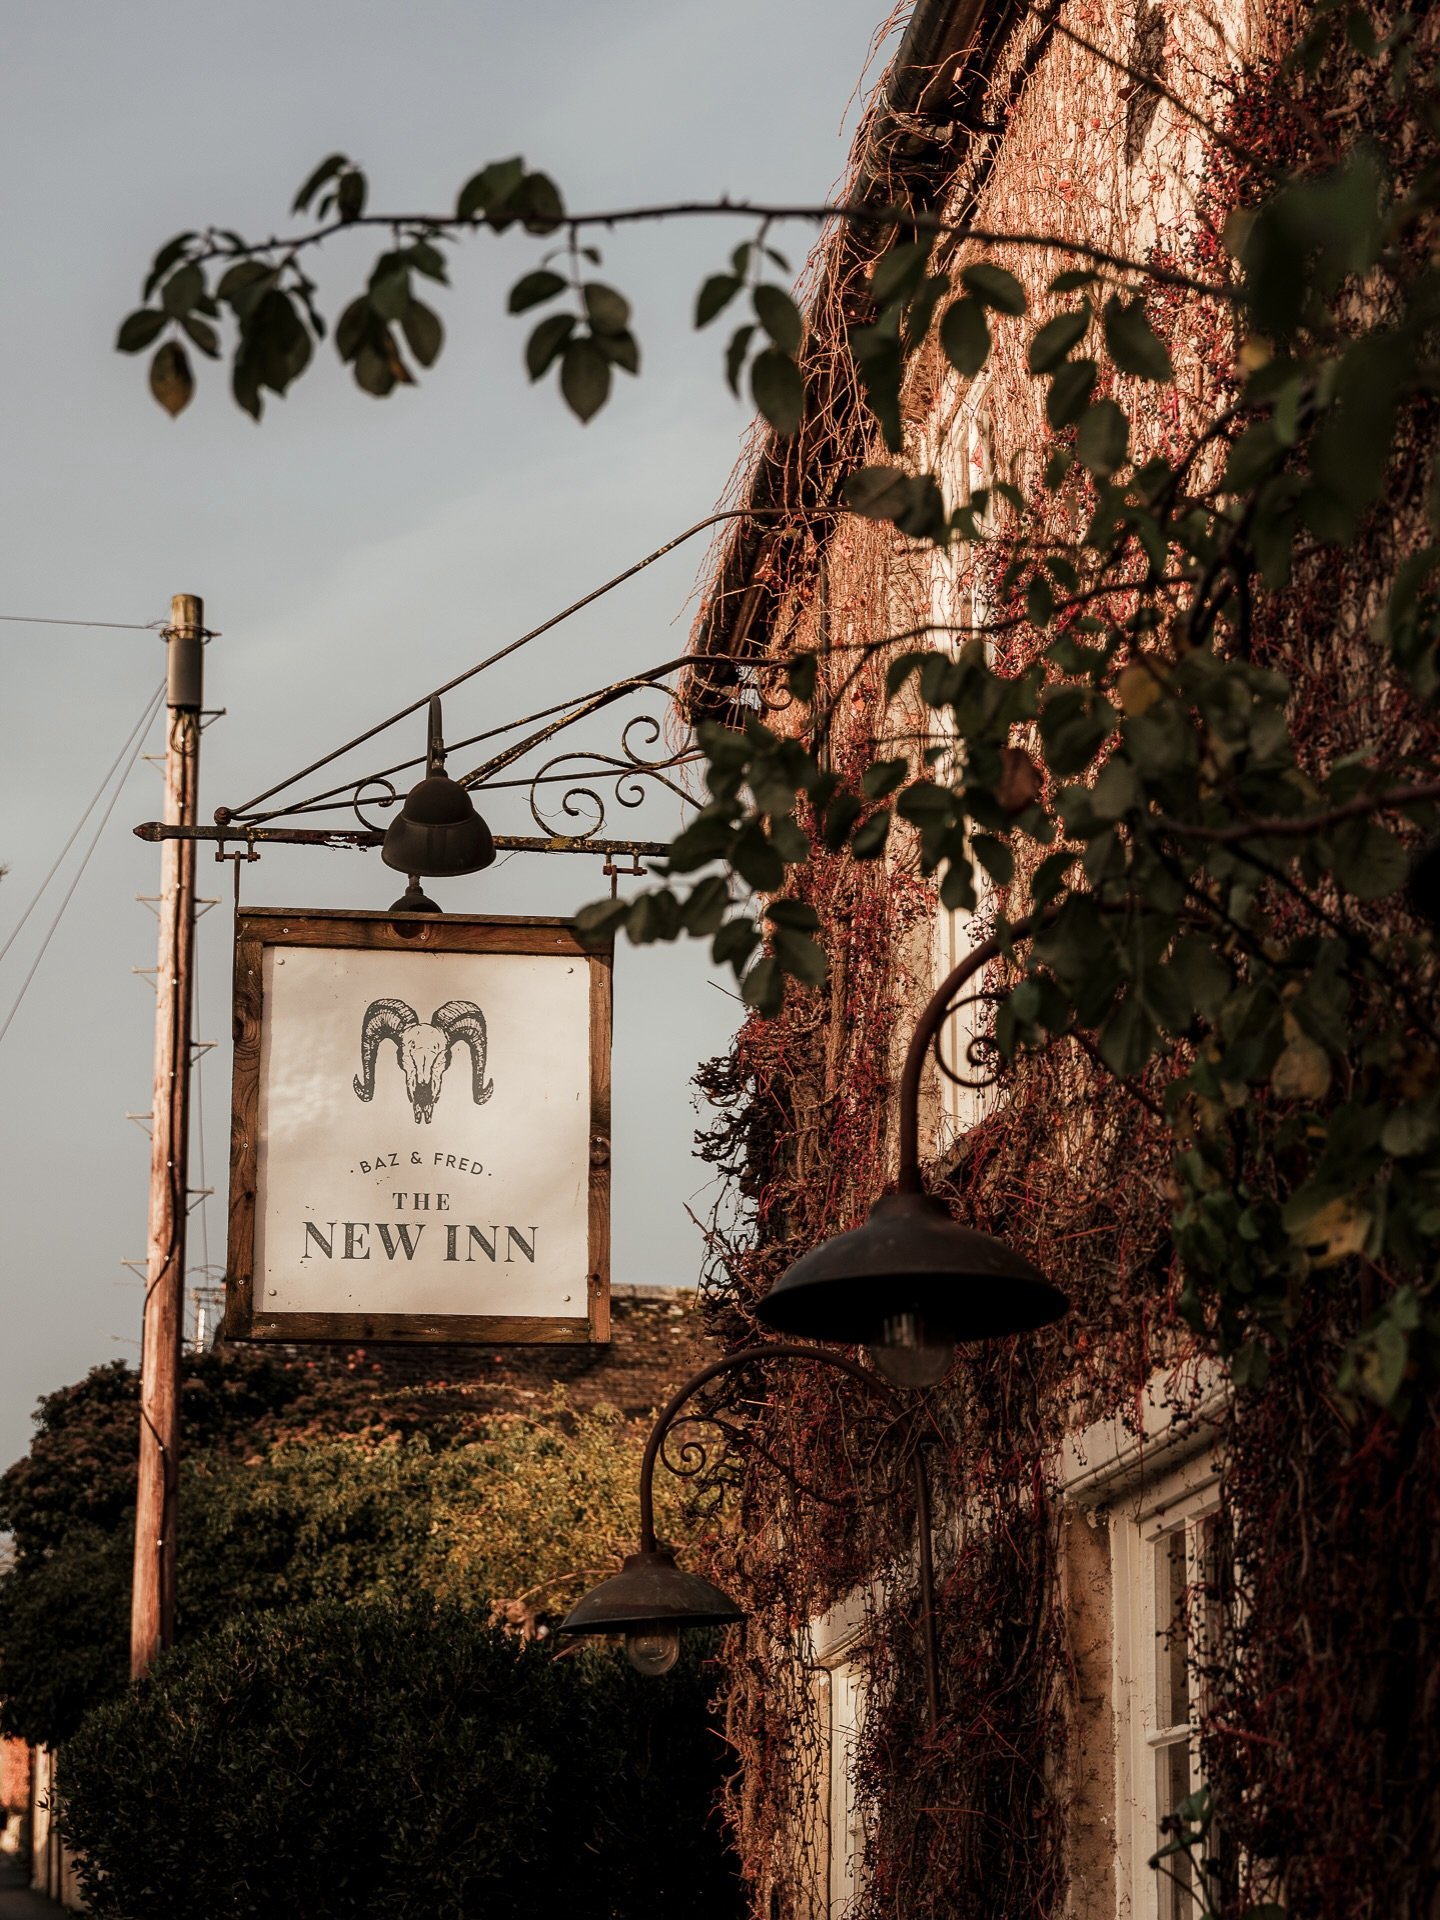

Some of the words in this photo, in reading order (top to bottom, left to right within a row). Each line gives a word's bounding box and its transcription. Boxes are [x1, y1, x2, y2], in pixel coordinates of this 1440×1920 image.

[359, 1152, 400, 1174] BAZ
[410, 1151, 423, 1165] &
[433, 1152, 483, 1175] FRED
[392, 1192, 450, 1211] THE
[301, 1221, 427, 1261] NEW
[443, 1224, 539, 1263] INN
